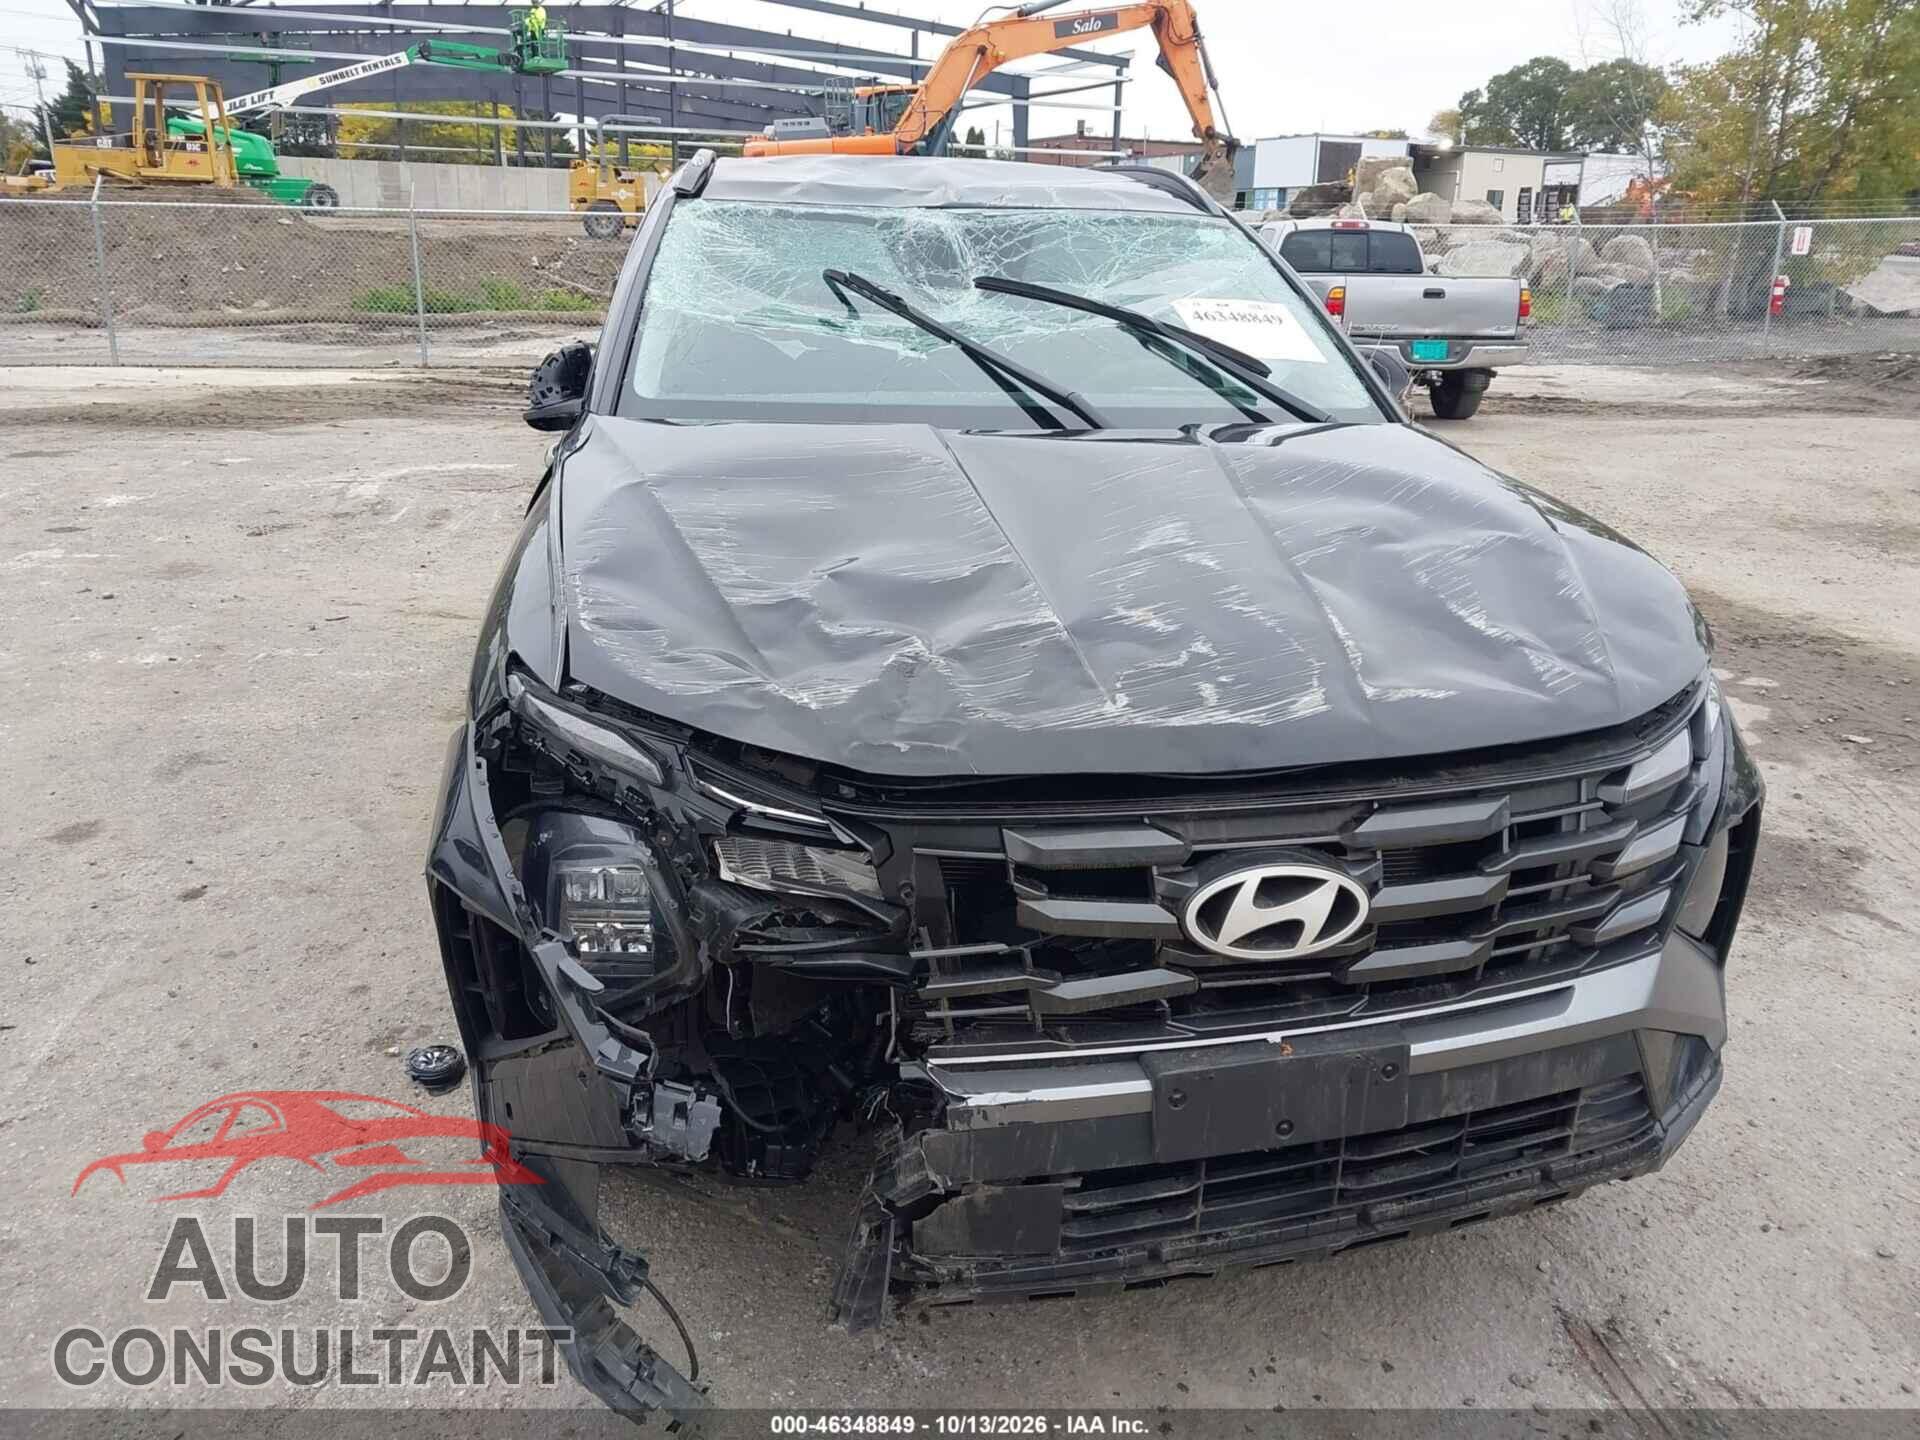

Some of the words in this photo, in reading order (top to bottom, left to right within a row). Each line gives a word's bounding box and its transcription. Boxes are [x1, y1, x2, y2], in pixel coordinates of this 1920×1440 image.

[1072, 16, 1102, 34] Salo
[318, 67, 361, 85] SUNBELT
[361, 56, 402, 74] RENTALS
[226, 97, 247, 112] JLG
[250, 90, 275, 105] LIFT
[1192, 310, 1283, 325] 46348849
